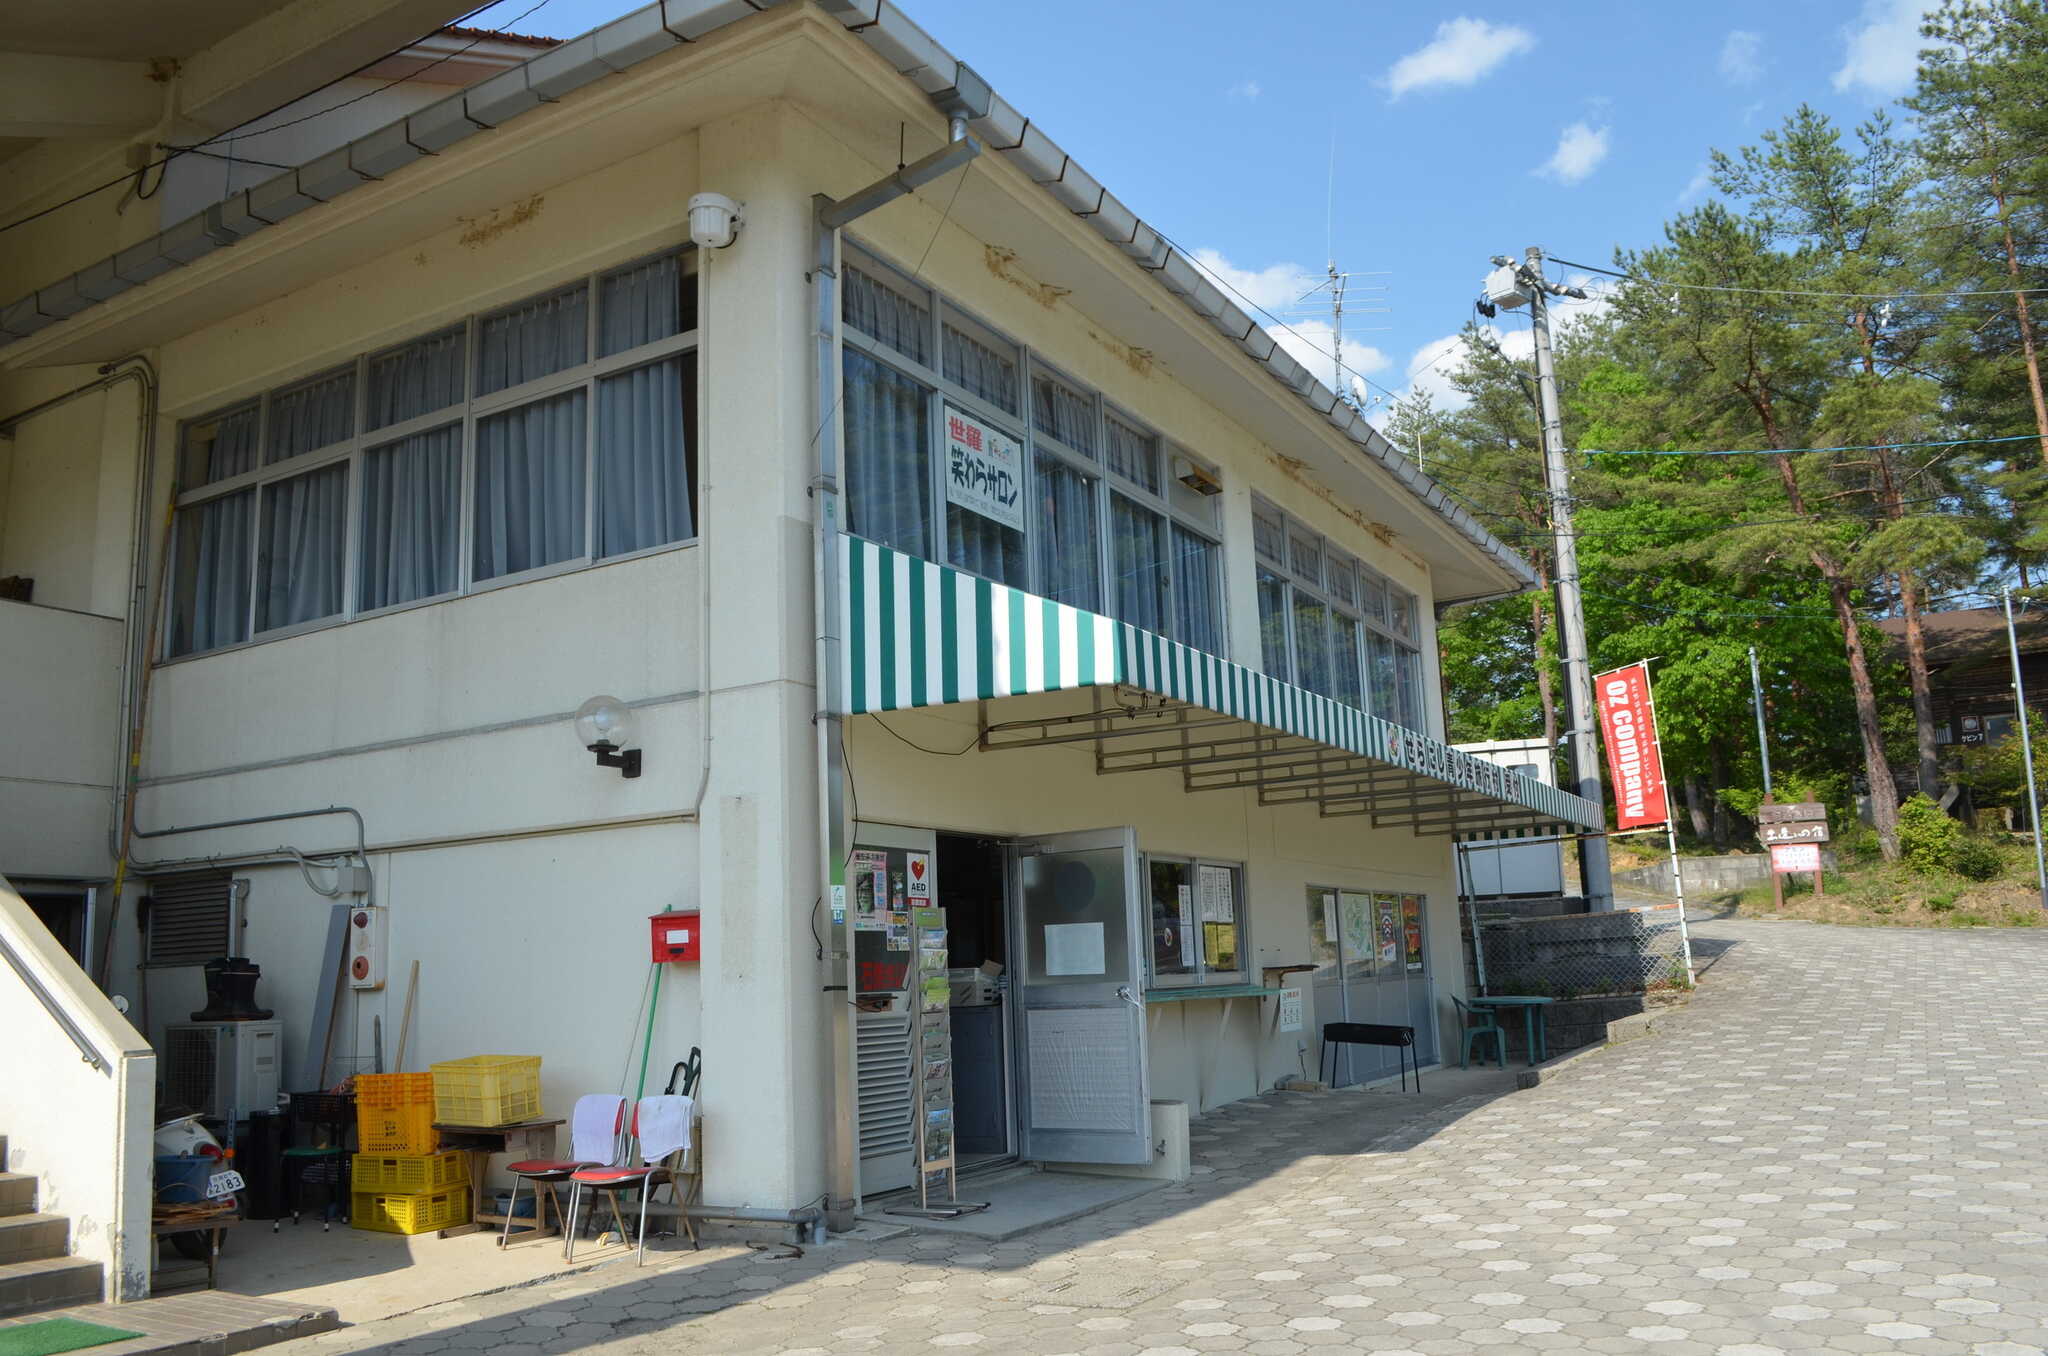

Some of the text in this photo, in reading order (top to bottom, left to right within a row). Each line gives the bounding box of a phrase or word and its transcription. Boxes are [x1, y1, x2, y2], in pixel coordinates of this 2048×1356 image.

[949, 416, 983, 452] 世羅
[951, 445, 1018, 508] 笑わらサロン
[911, 882, 926, 892] AED
[214, 1176, 241, 1193] 2183
